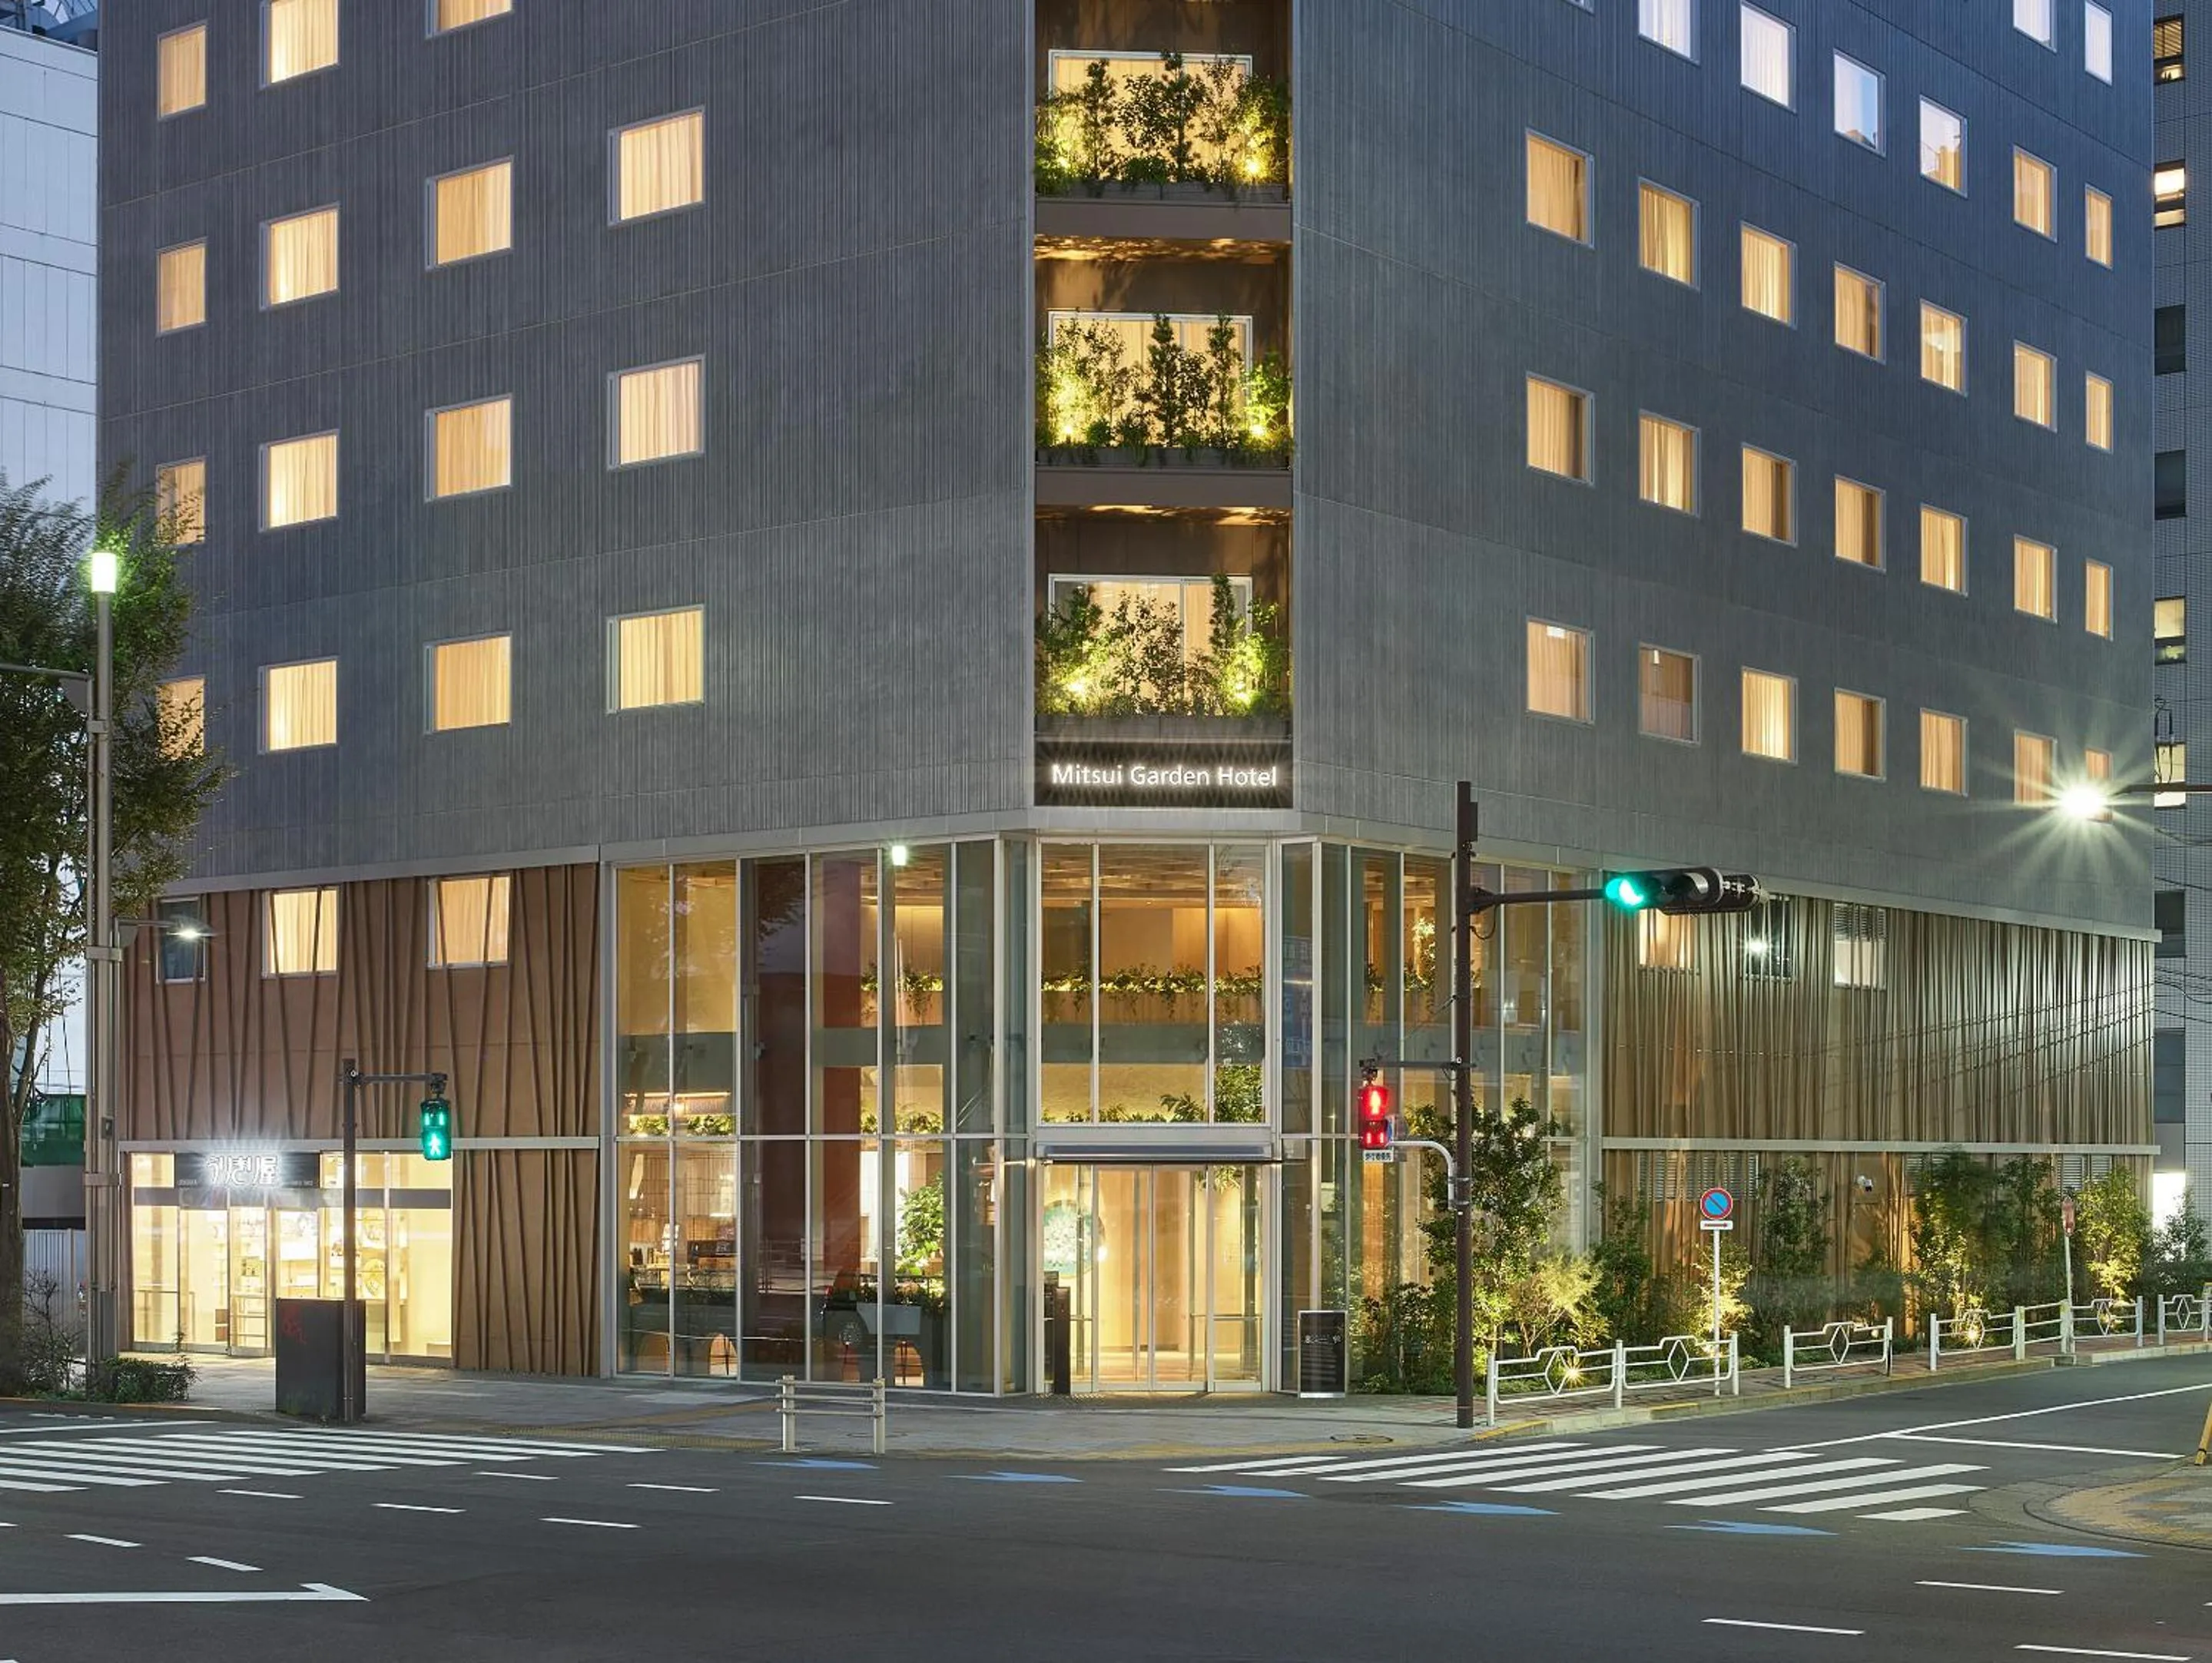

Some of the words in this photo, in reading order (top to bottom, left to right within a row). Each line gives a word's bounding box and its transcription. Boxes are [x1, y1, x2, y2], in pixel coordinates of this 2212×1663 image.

[1052, 765, 1122, 783] Mitsui
[1130, 765, 1209, 785] Garden
[1218, 766, 1276, 786] Hotel
